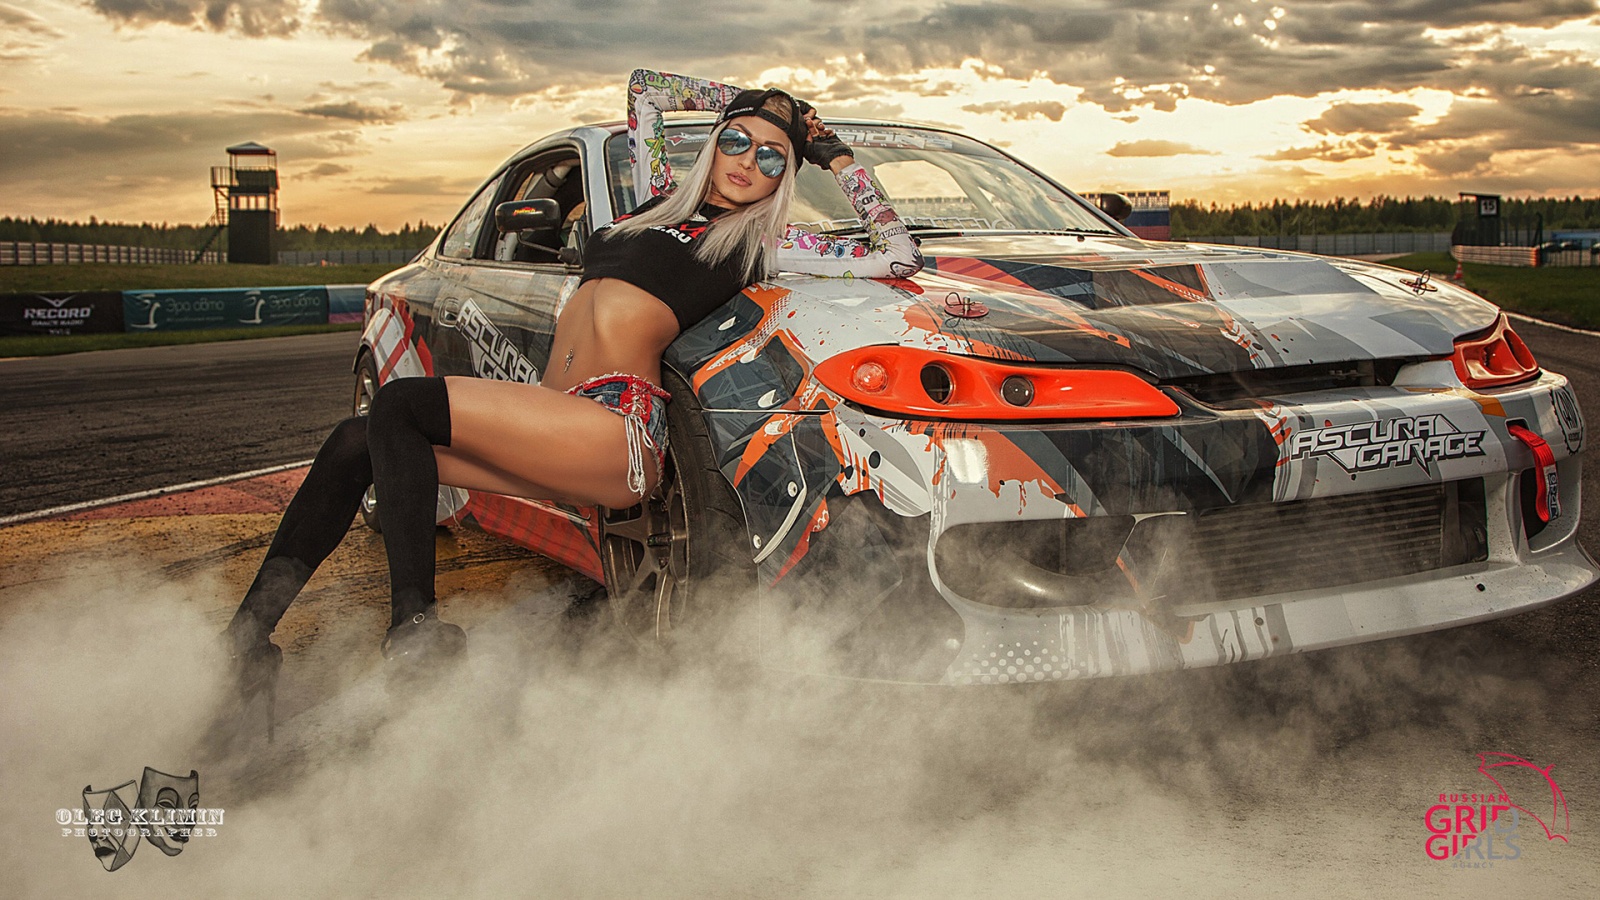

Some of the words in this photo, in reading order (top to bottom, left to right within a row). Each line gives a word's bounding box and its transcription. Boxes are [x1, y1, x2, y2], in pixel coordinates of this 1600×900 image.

[1483, 200, 1495, 211] 15
[24, 307, 91, 319] RECORD
[457, 298, 538, 384] ASCURA
[1291, 414, 1459, 456] ASCURA
[1350, 432, 1484, 473] GARAGE
